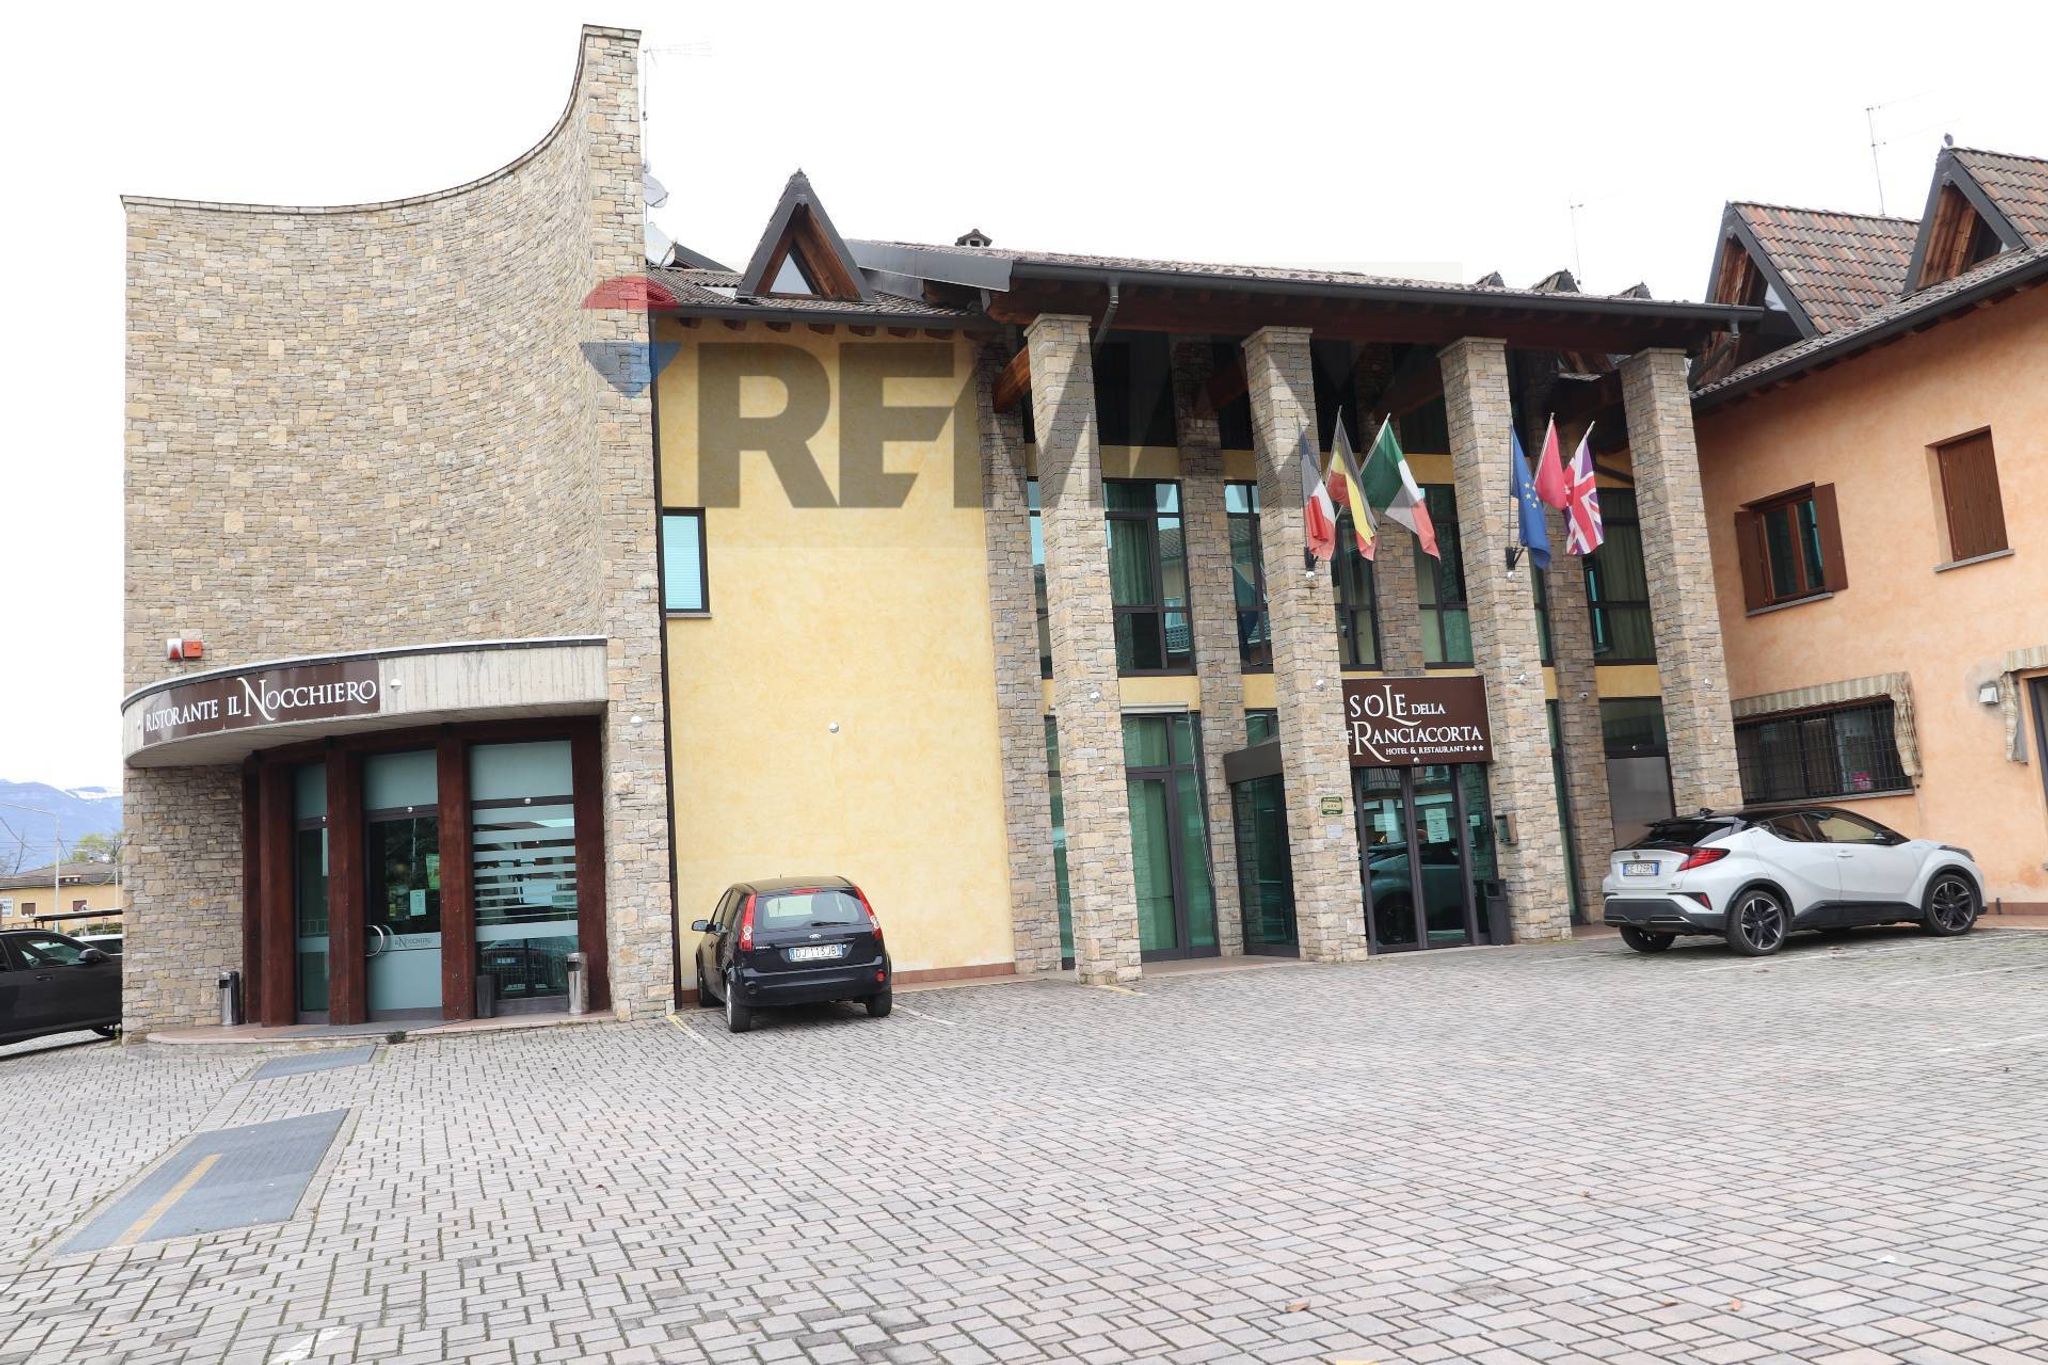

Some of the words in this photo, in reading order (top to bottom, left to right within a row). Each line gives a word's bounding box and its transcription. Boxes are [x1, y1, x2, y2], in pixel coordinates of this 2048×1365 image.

[146, 700, 219, 732] RISTORANTE
[227, 696, 241, 717] IL
[237, 677, 377, 721] NOCCHIERO
[1349, 684, 1422, 726] SOLE
[1411, 703, 1446, 715] DELLA
[1346, 720, 1484, 762] FRANCIACORTA
[1385, 747, 1408, 755] HOTEL
[1410, 746, 1417, 754] &
[1418, 745, 1464, 755] RESTAURANT
